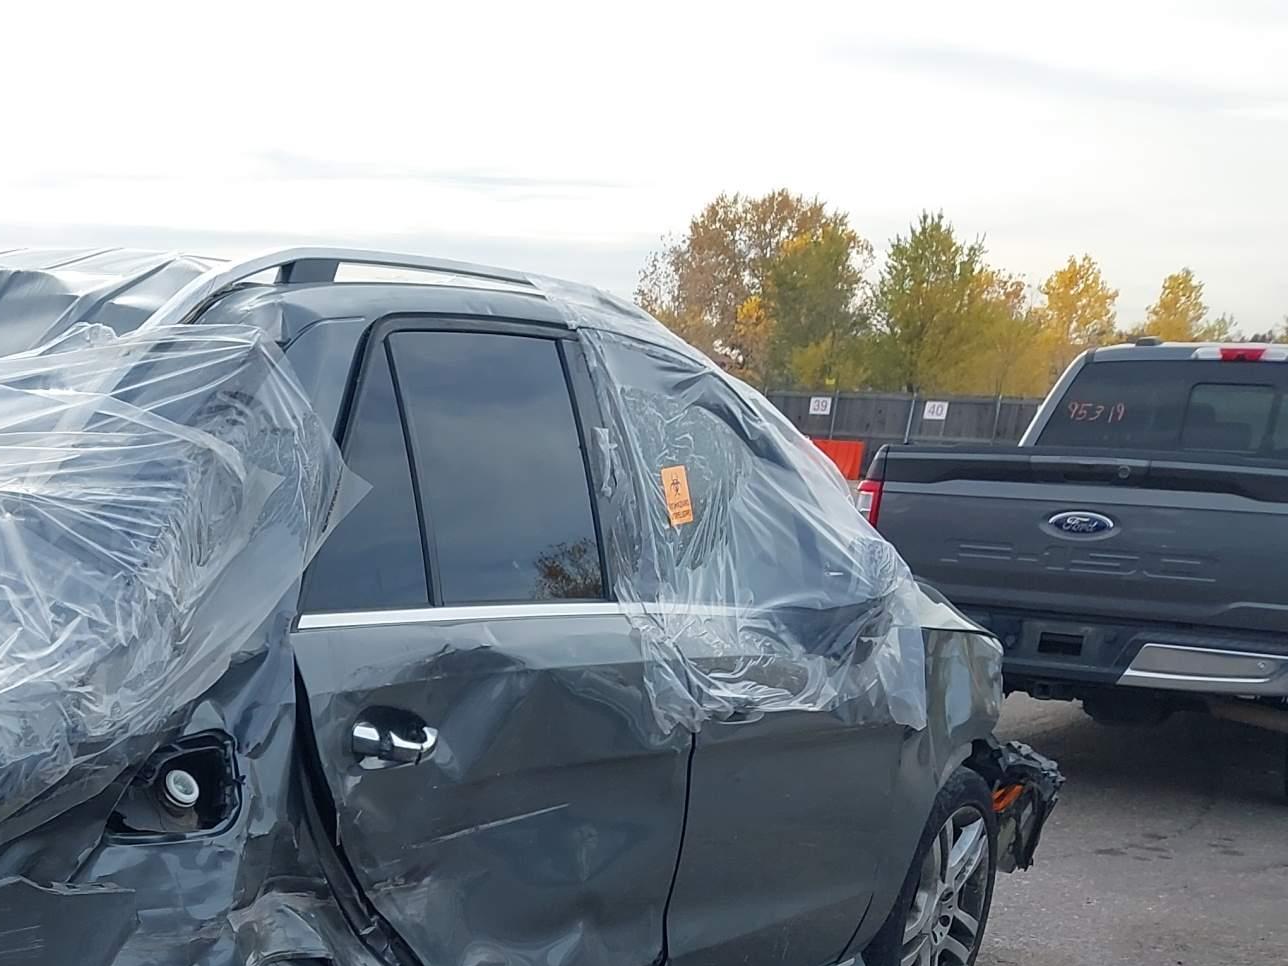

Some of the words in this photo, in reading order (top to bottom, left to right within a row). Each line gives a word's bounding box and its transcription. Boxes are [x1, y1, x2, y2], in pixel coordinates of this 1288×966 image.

[813, 399, 828, 412] 39
[927, 403, 944, 417] 40
[1068, 401, 1125, 423] 95319
[1063, 516, 1098, 531] Ford
